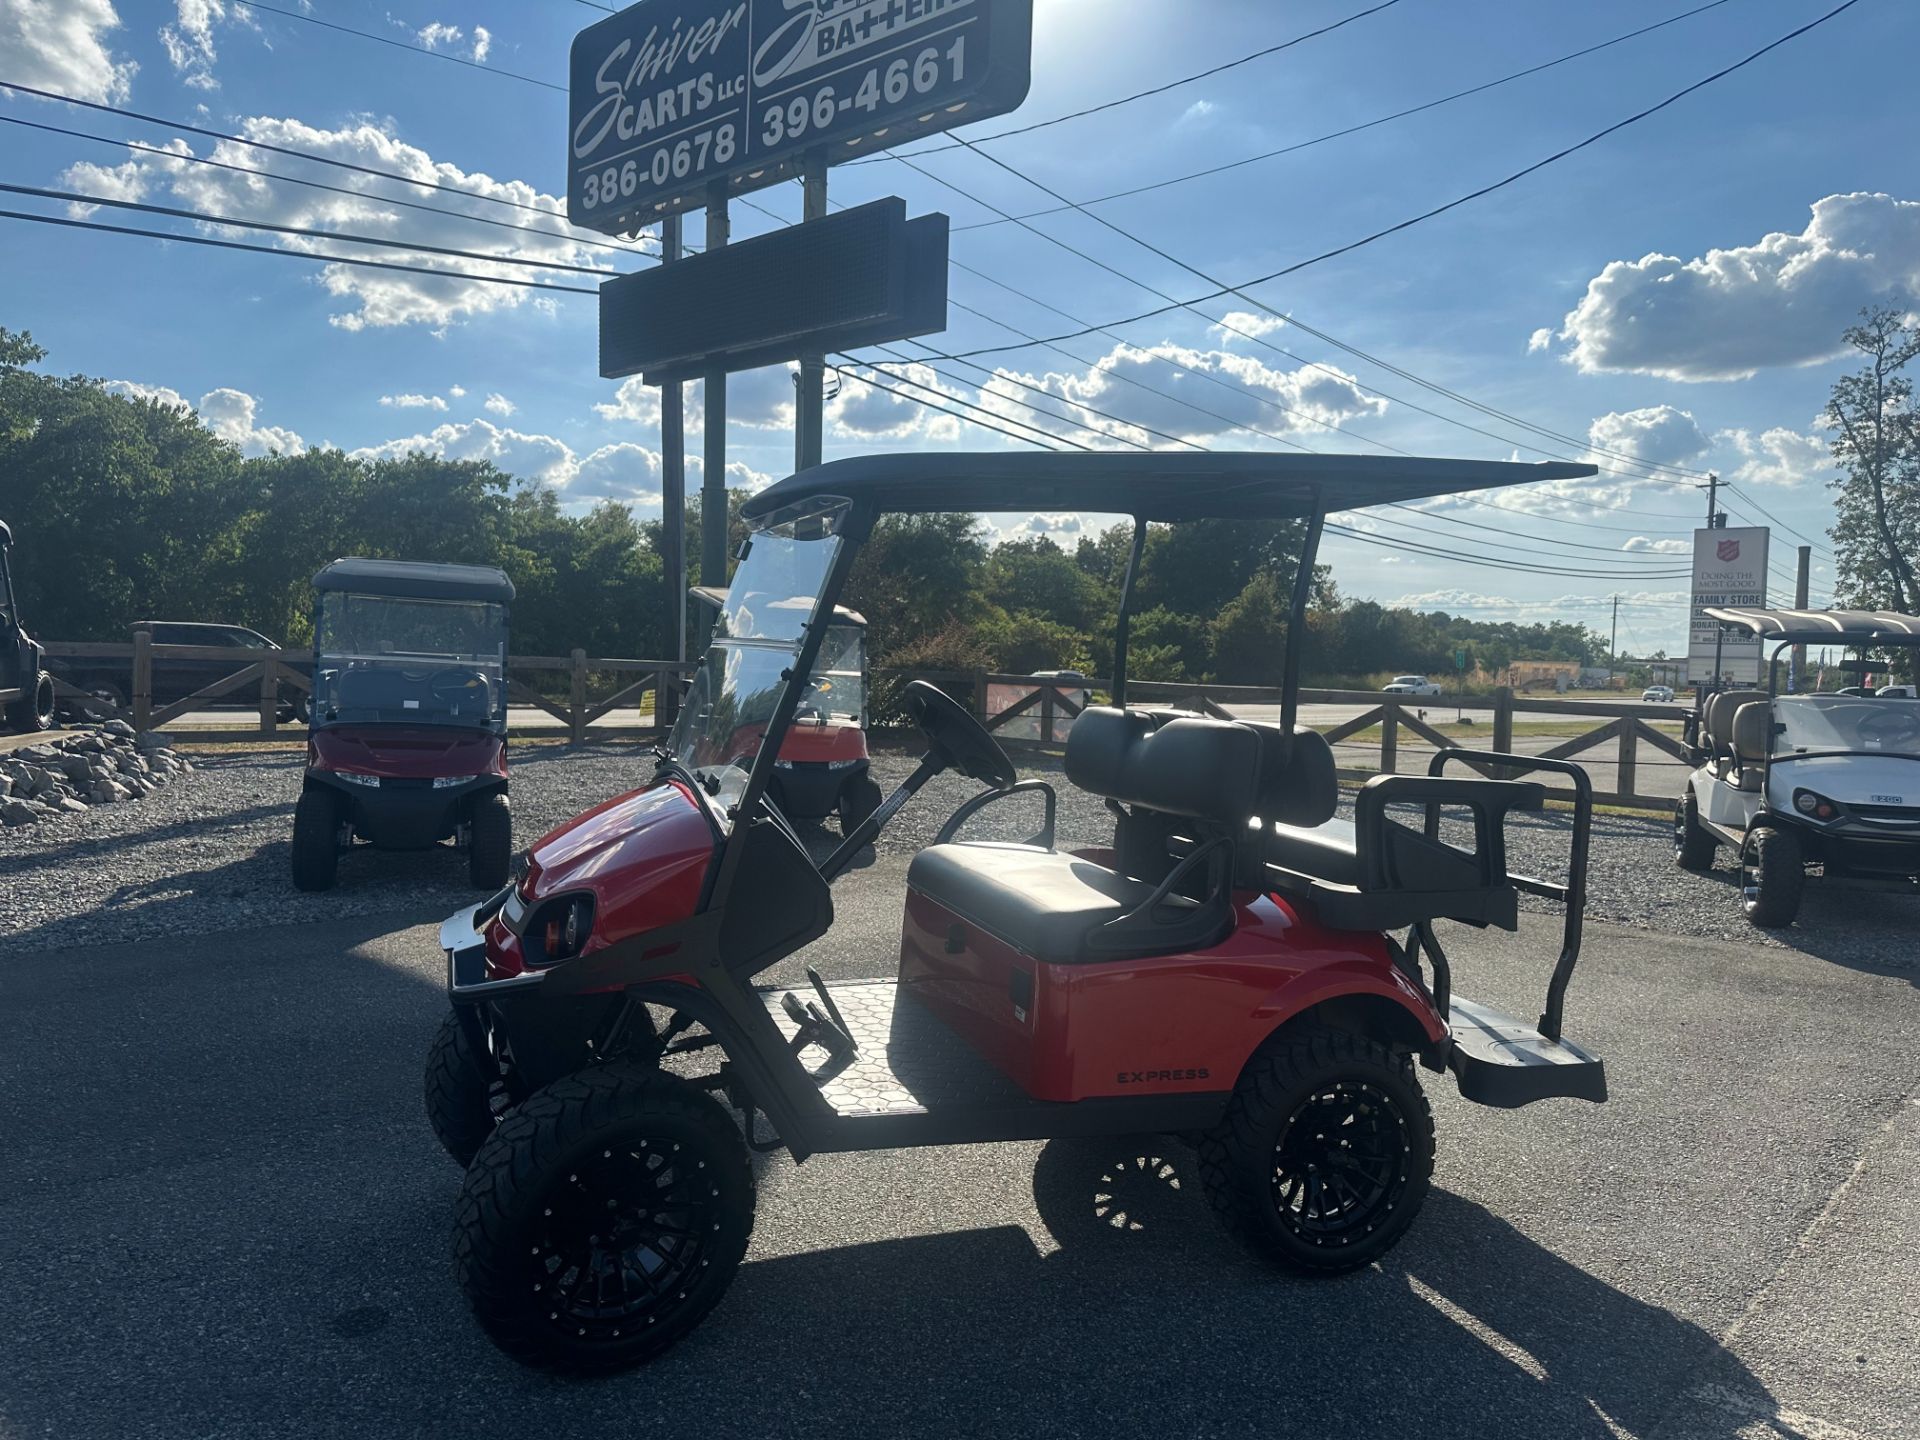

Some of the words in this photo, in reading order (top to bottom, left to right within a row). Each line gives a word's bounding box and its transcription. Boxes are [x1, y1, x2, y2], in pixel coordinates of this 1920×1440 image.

[573, 2, 747, 159] Shiver
[762, 35, 965, 147] 396-4661
[616, 72, 714, 141] CARTS
[717, 75, 745, 102] LLC
[582, 123, 736, 210] 386-0678
[1699, 580, 1725, 588] MOST
[1726, 580, 1756, 588] GOOD
[1701, 571, 1734, 580] DOING
[1736, 571, 1753, 580] THE
[1694, 594, 1727, 605] FAMILY
[1730, 594, 1761, 605] STORE
[1117, 1068, 1210, 1084] EXPRESS
